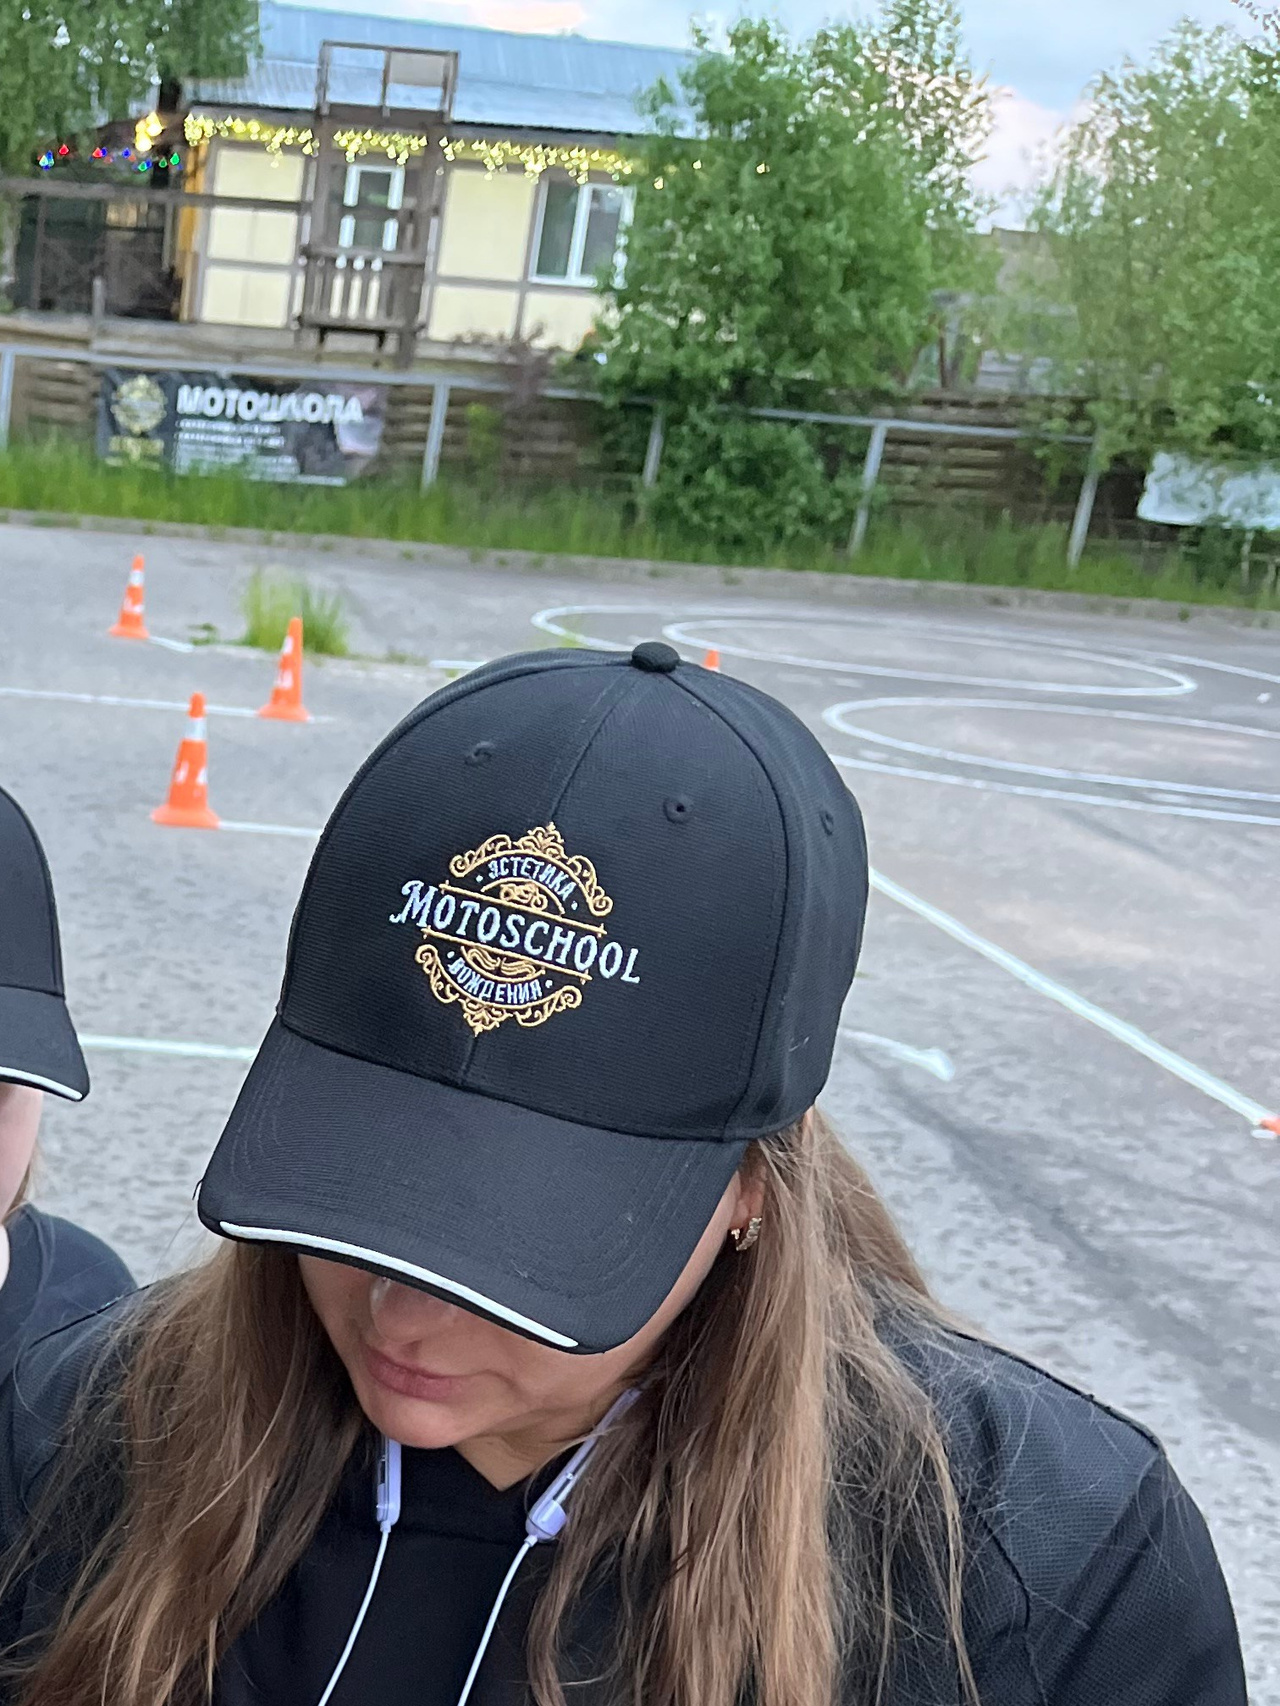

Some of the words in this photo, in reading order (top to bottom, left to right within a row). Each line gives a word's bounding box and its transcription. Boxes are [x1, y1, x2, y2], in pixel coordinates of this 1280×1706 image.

[176, 384, 364, 424] МОТОШКОЛА
[488, 857, 577, 902] ЭСТЕТИКА
[389, 880, 641, 984] MOTOSCHOOL
[447, 956, 542, 1004] ВОЖДЕНИЯ
